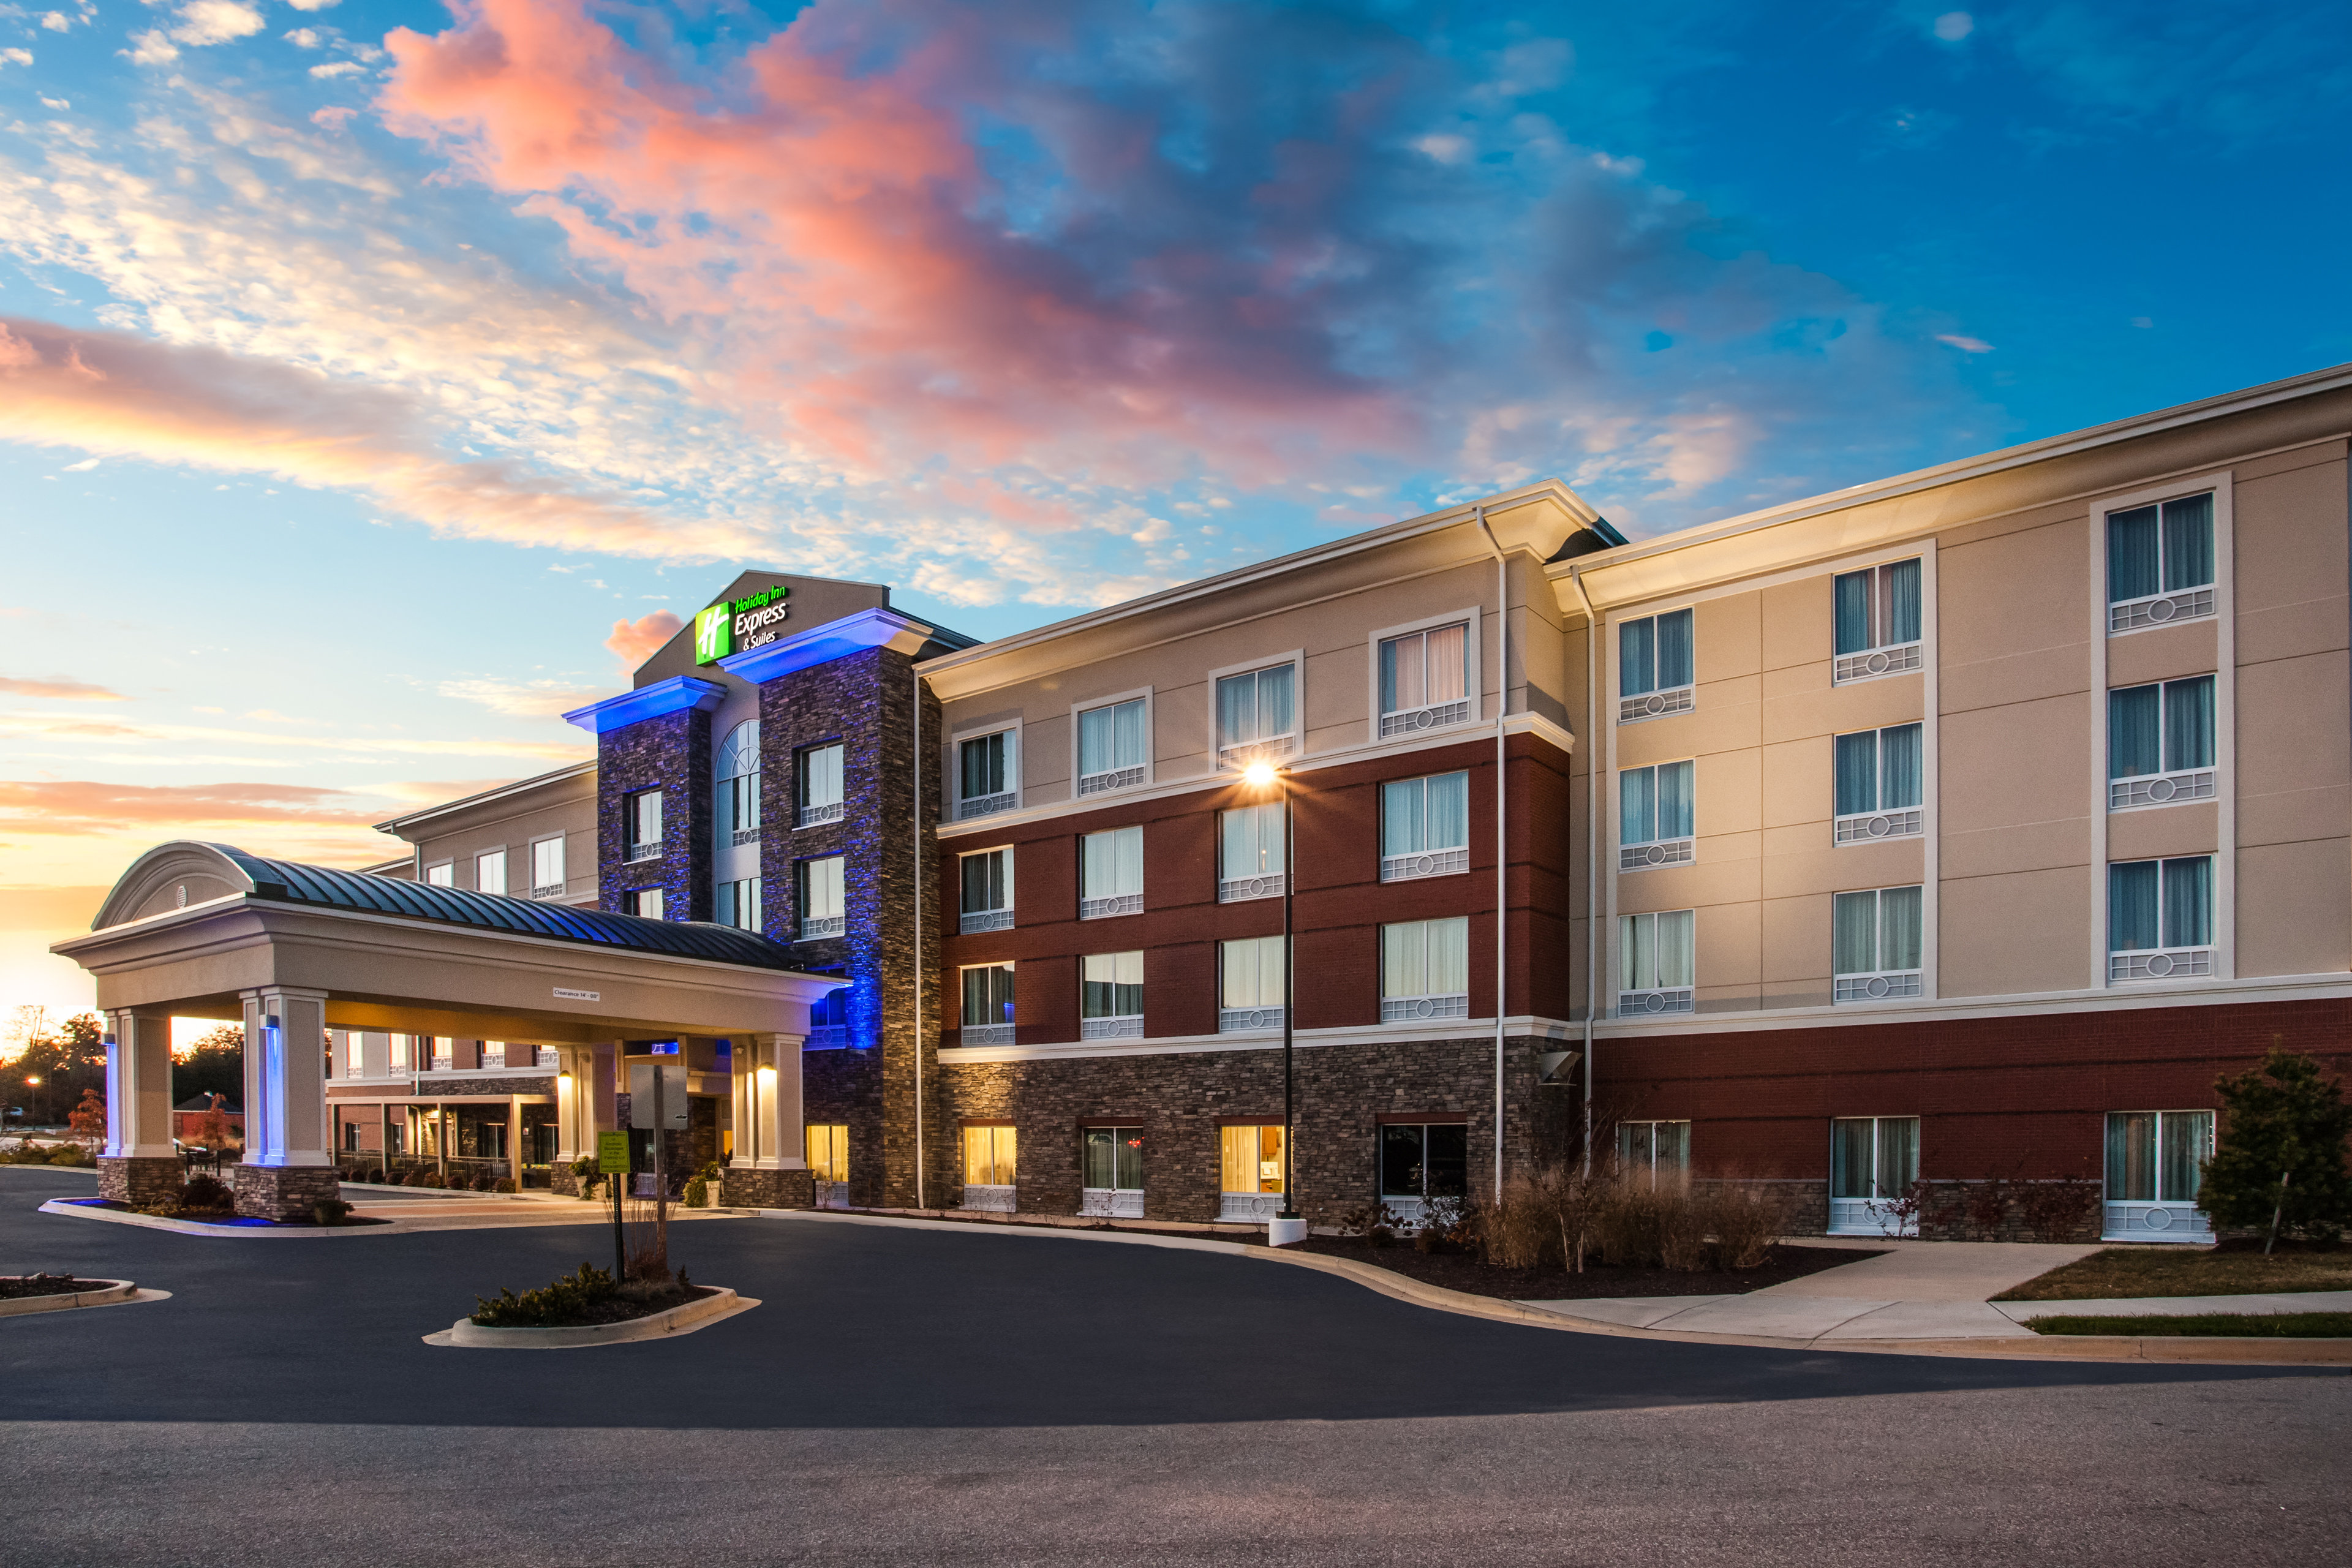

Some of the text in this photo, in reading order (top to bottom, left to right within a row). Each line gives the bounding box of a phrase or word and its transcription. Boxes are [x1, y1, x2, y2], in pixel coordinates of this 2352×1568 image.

[735, 585, 785, 614] Holiday Inn
[735, 603, 786, 636] Express
[743, 631, 775, 651] & Suites
